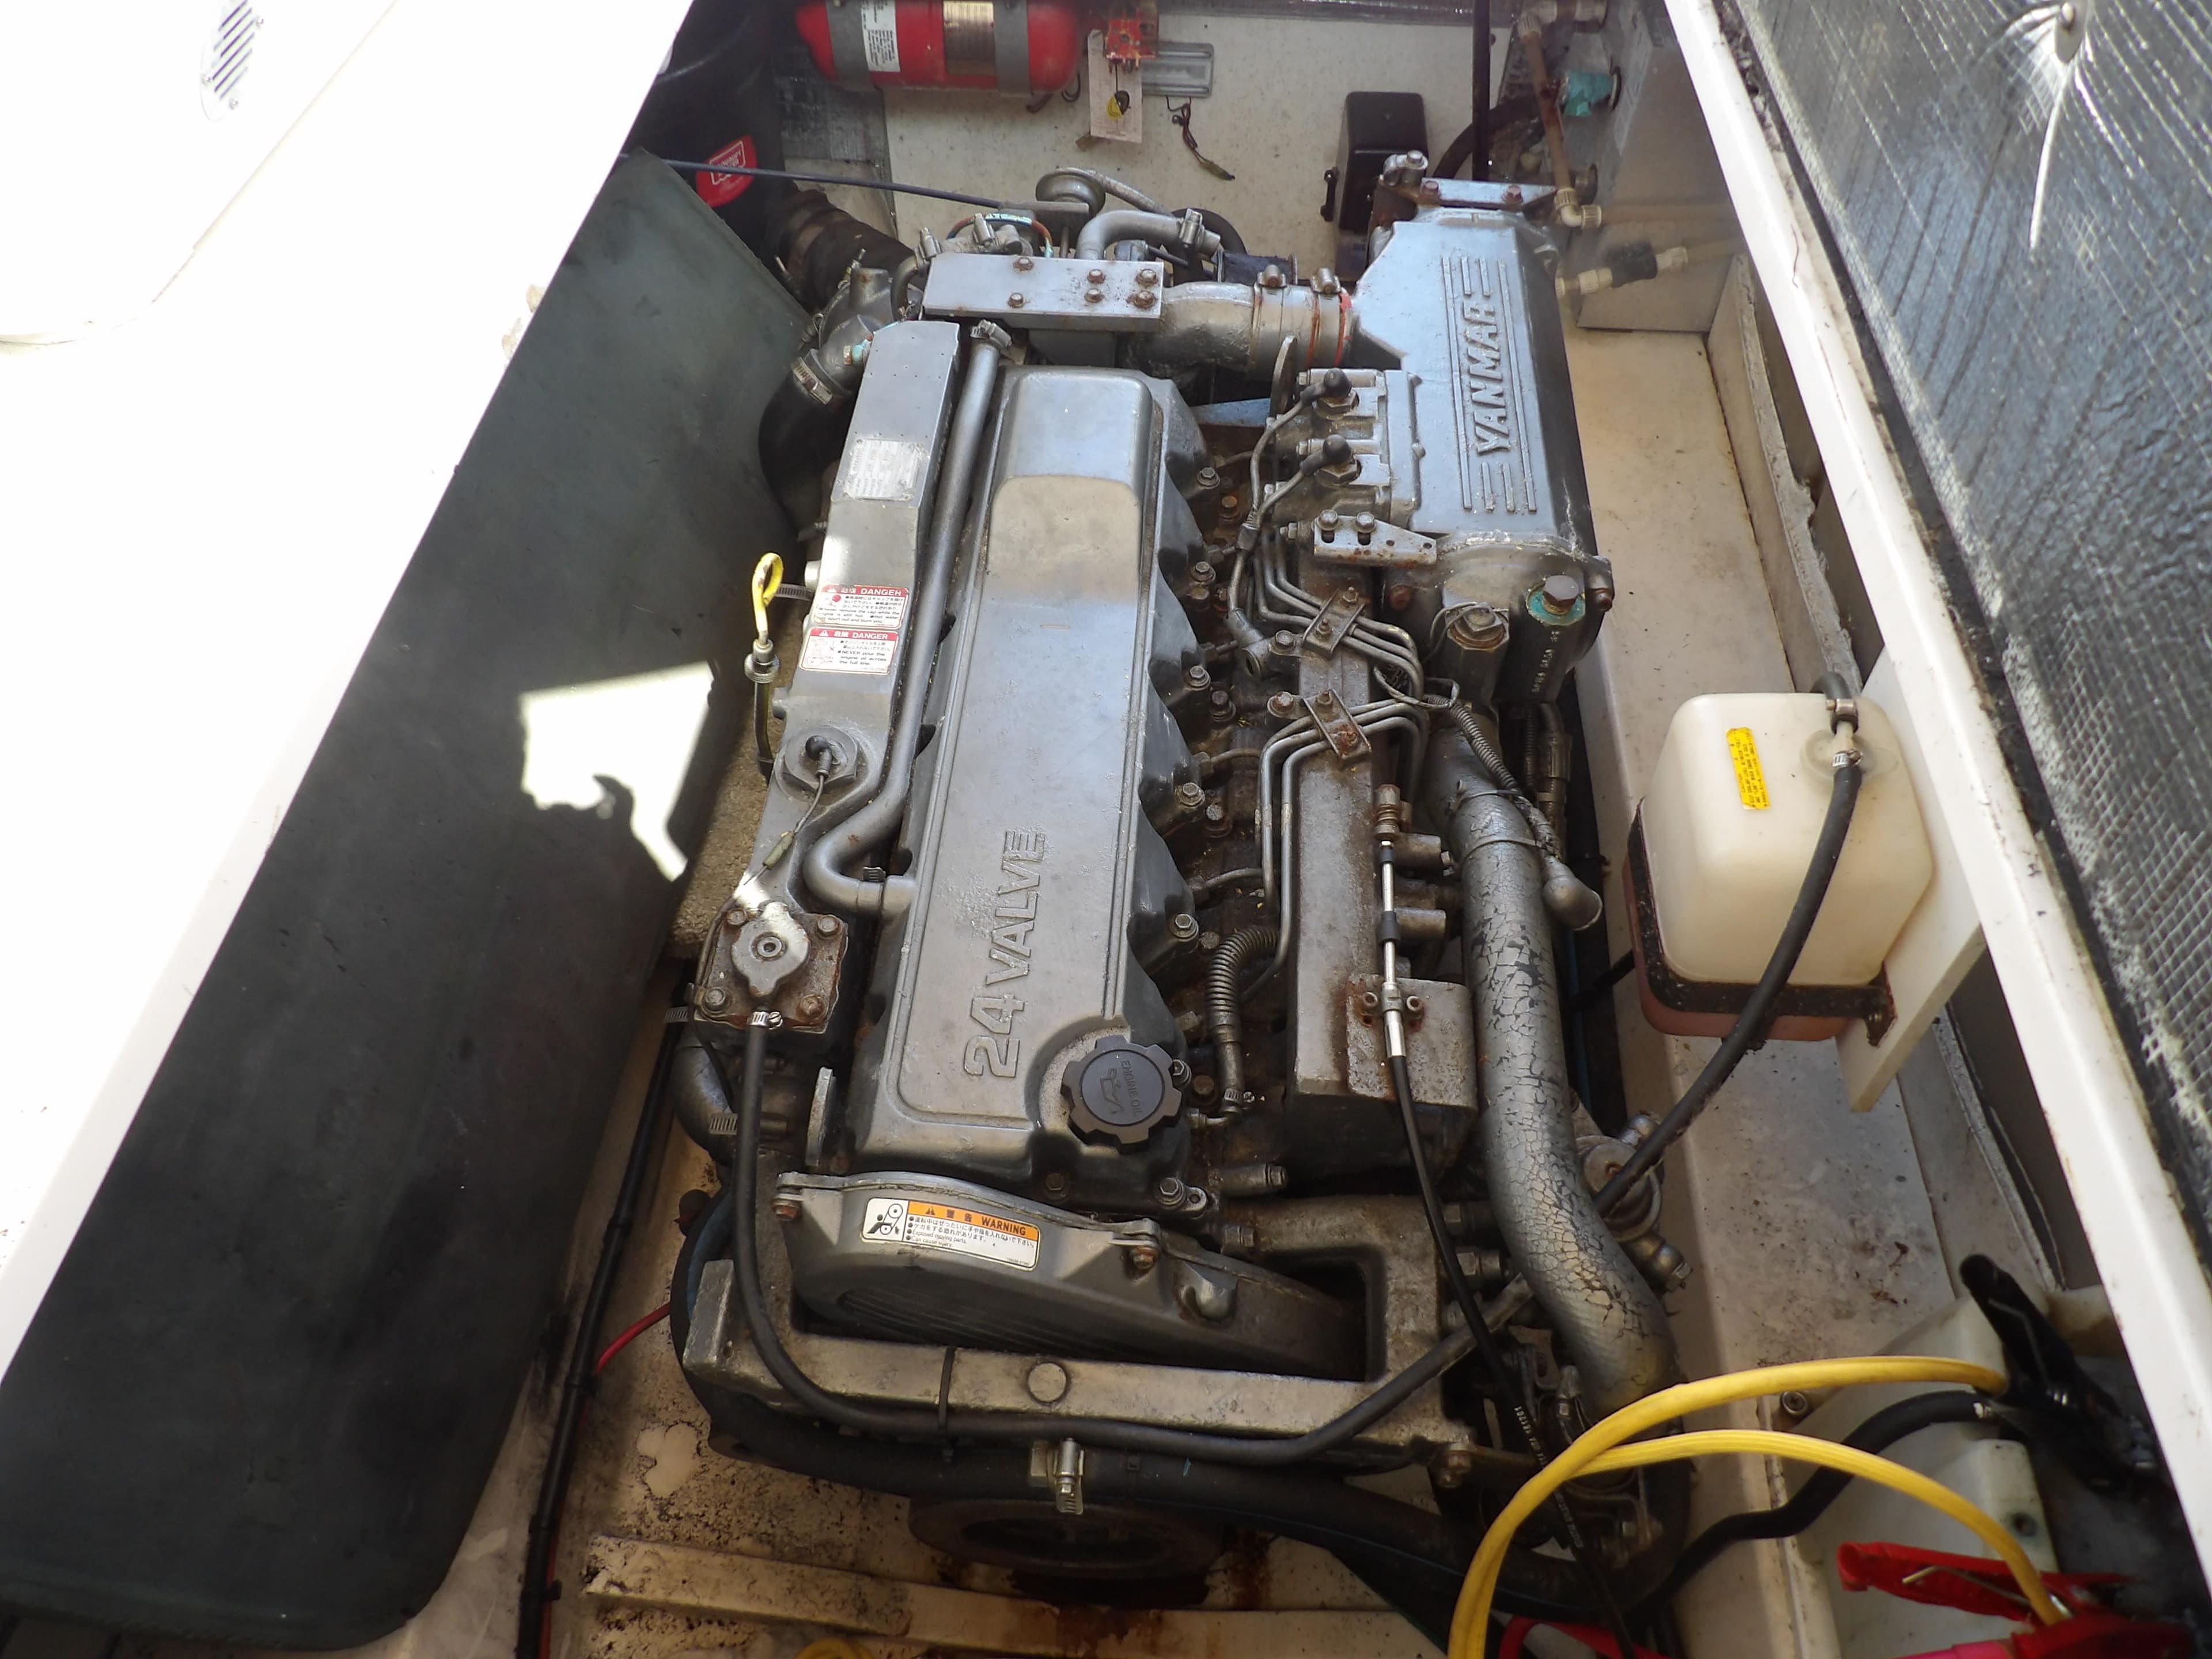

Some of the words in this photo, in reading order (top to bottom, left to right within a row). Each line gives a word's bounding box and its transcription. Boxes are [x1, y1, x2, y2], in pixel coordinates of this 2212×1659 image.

[1463, 300, 1512, 456] YANMAR
[986, 831, 1046, 986] VALVE
[964, 993, 1025, 1078] 24
[1120, 1060, 1138, 1097] ENGINE
[1130, 1099, 1143, 1116] OIL
[912, 1229, 933, 1237] Exposed
[934, 1234, 952, 1242] moving
[982, 1216, 1026, 1235] WARNING
